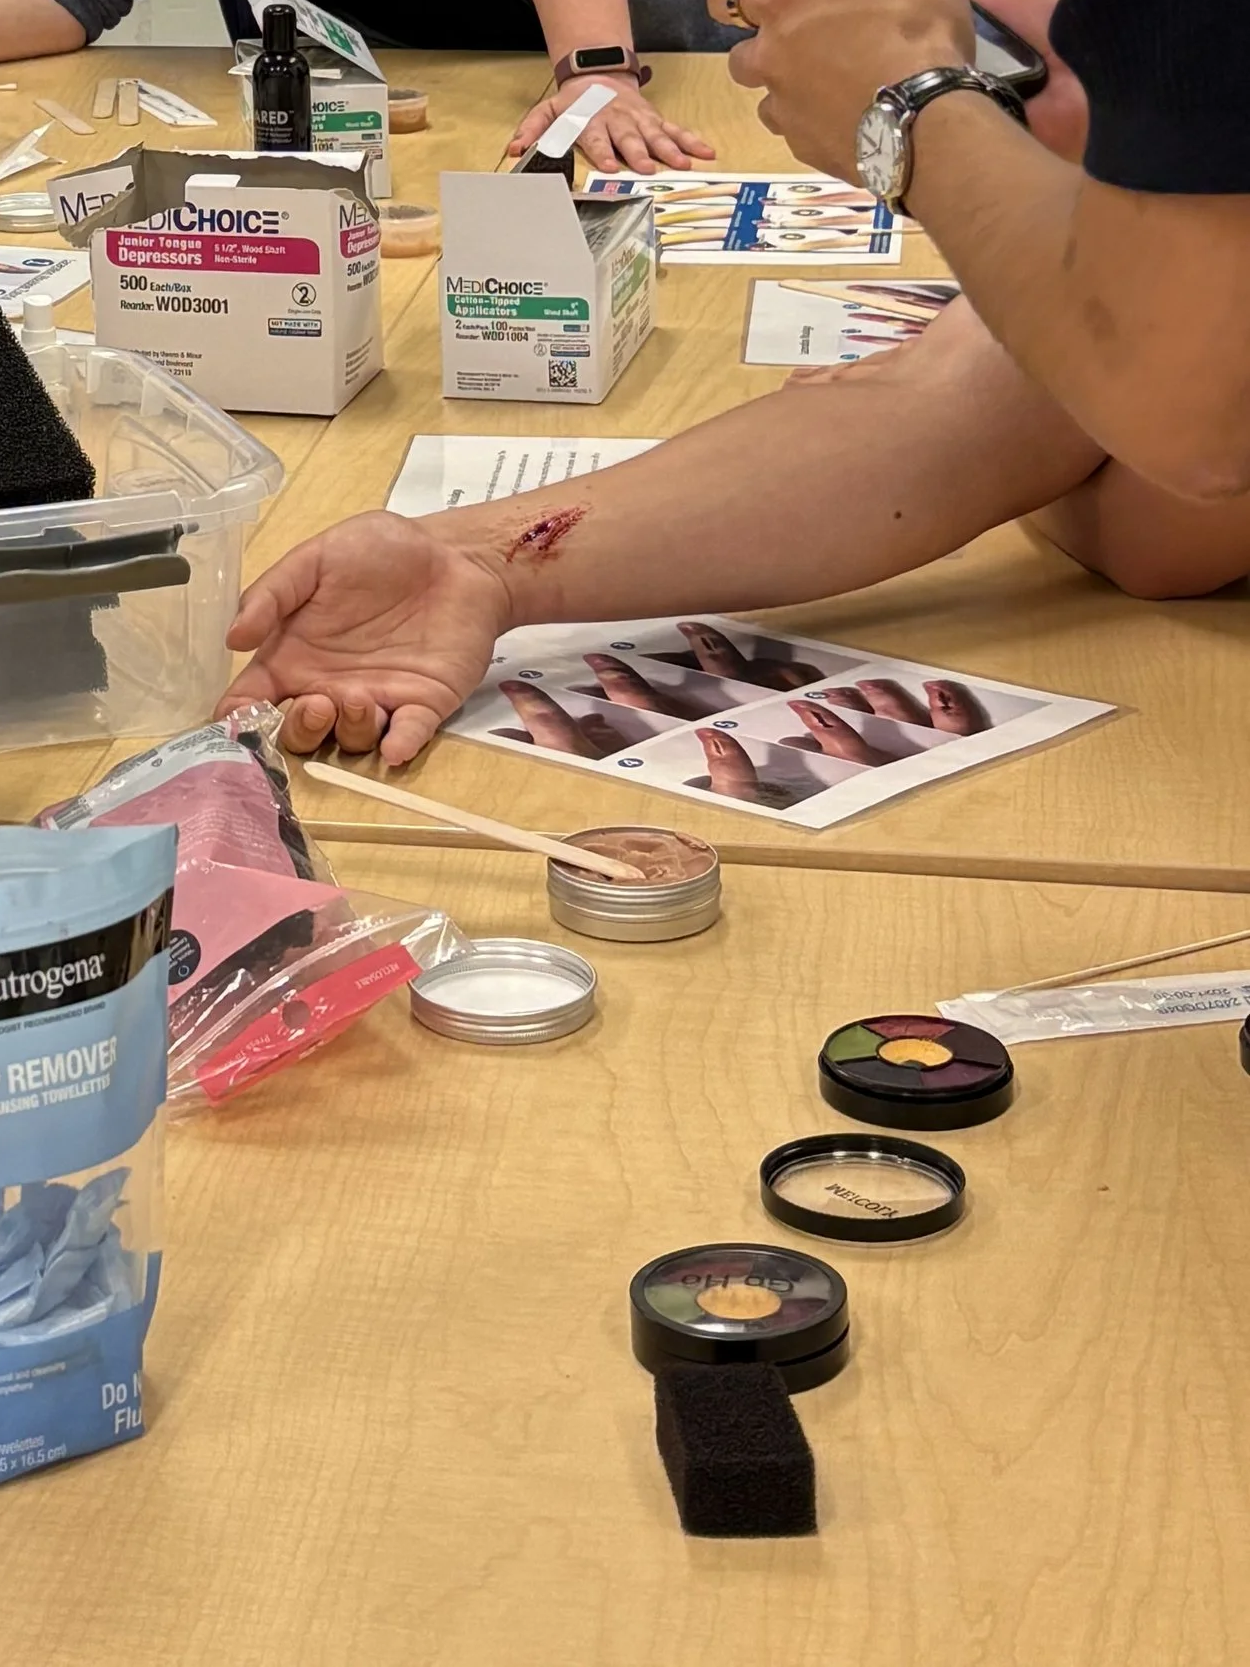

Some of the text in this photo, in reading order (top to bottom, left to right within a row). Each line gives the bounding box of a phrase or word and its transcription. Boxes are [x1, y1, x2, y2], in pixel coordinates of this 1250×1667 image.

[118, 235, 155, 247] Junior
[158, 236, 202, 250] Tongue
[242, 245, 264, 254] Wood
[265, 245, 286, 254] Shaft
[118, 246, 257, 266] Depressors Non-Sterile
[120, 274, 192, 293] 500 Each/Box
[120, 295, 229, 314] Reorder: WOD3001
[454, 295, 521, 306] Cotton-Tipped
[454, 305, 518, 317] Applicators
[455, 320, 462, 330] 2
[491, 321, 508, 331] 100
[481, 331, 529, 342] WOD1004
[24, 1009, 83, 1030] RECOMMENDED
[83, 1001, 106, 1015] BRAND
[7, 1036, 118, 1095] REMOVER
[102, 1382, 128, 1411] Do
